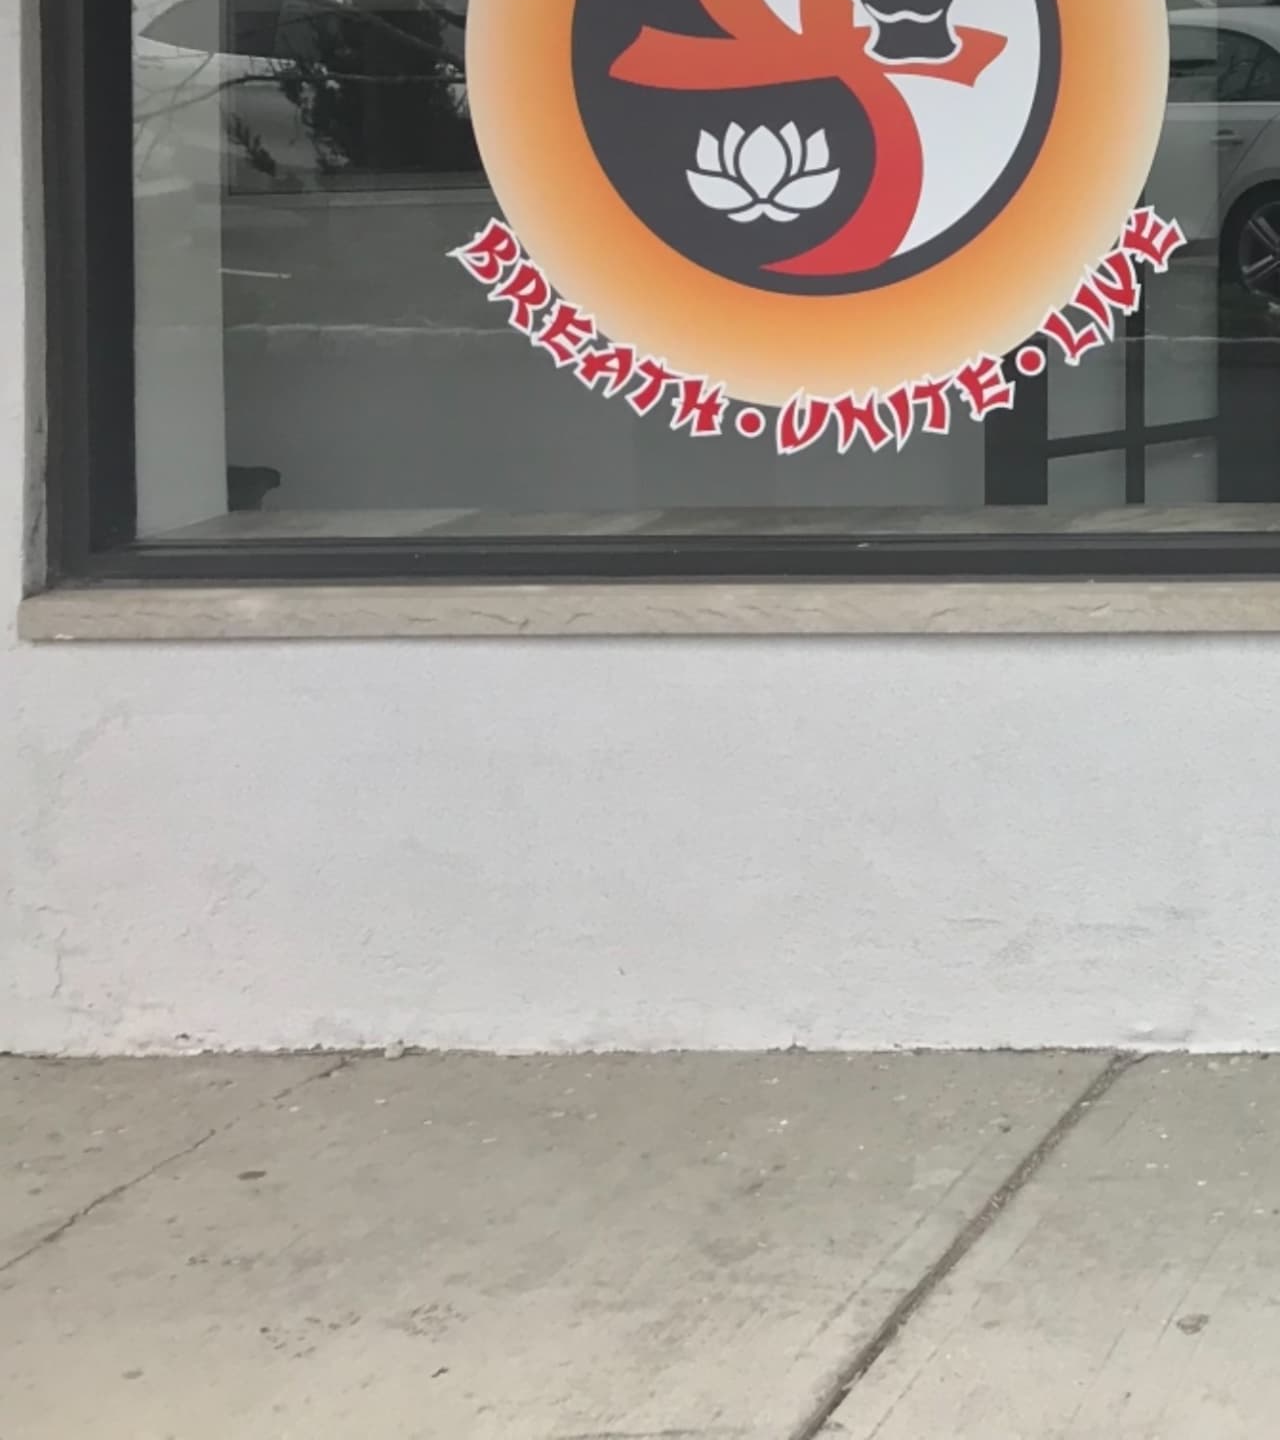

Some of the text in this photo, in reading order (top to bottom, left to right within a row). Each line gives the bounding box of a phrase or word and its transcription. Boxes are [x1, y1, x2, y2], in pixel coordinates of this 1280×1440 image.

[447, 203, 1188, 454] BREATH UNITE LIVE
